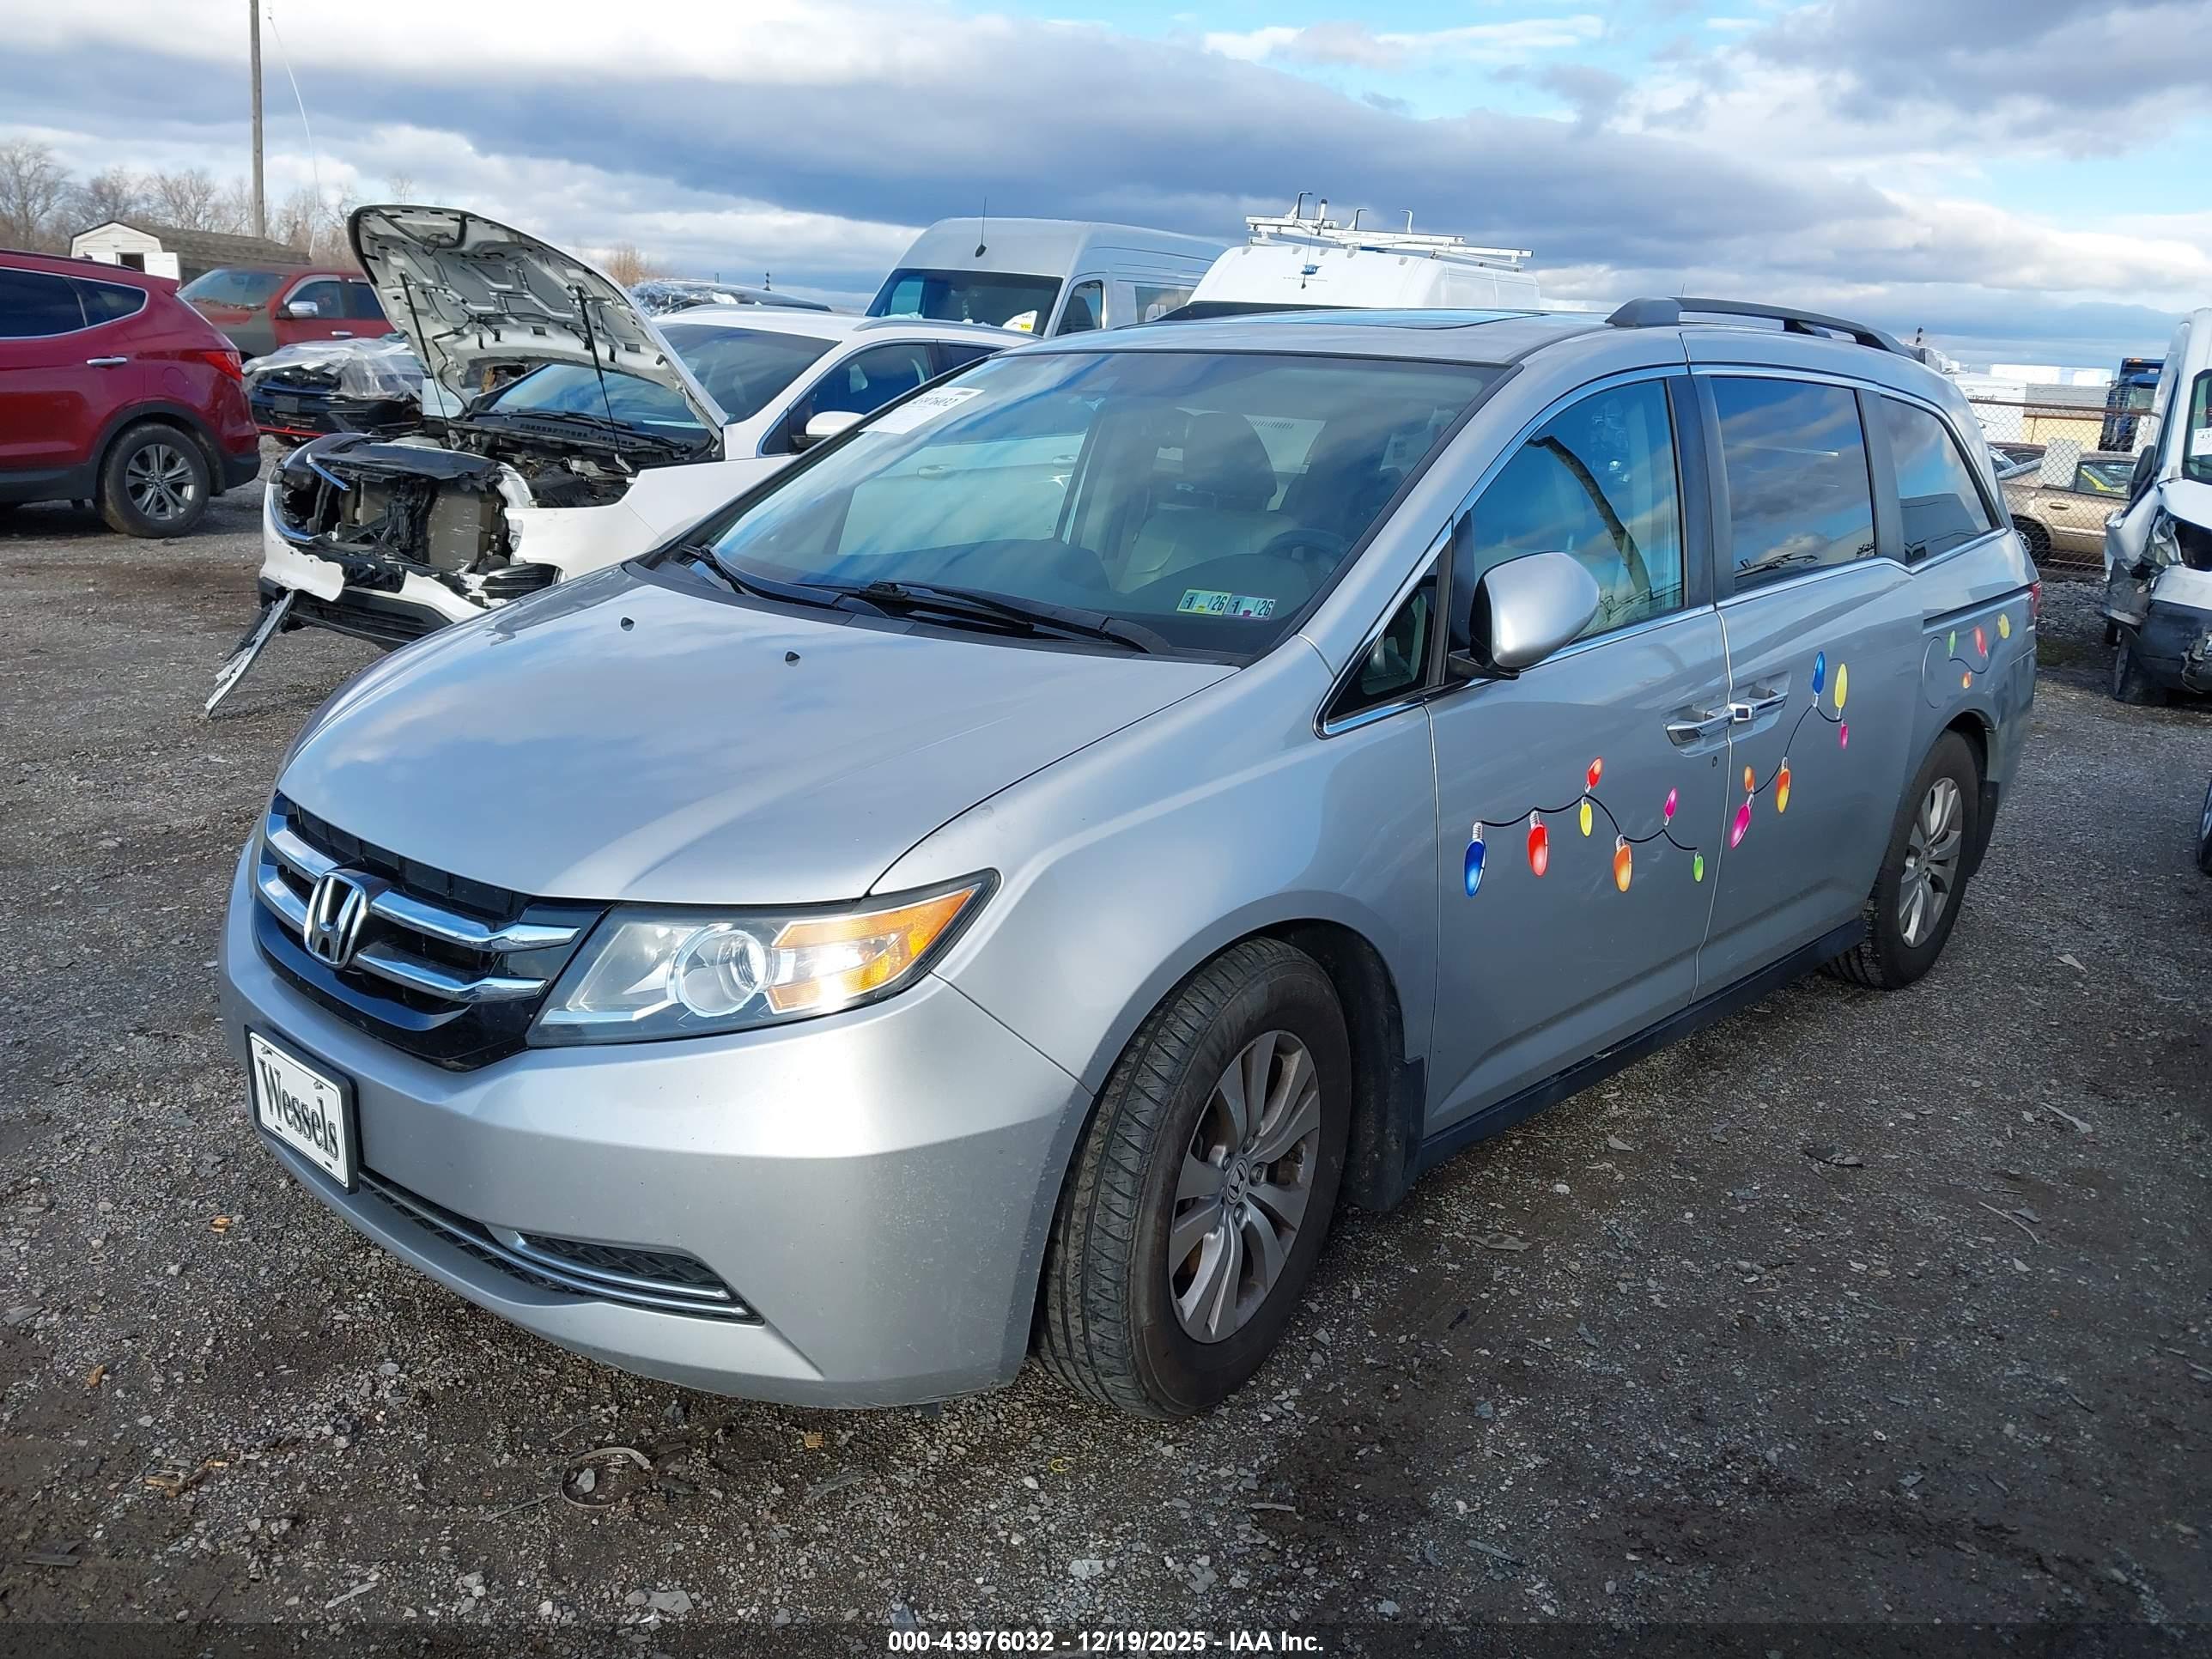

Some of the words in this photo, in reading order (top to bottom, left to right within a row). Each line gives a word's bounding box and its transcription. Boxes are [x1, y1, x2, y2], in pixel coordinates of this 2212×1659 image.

[1212, 595, 1228, 611] 26
[1258, 599, 1274, 616] 26
[257, 1056, 339, 1161] Wessels
